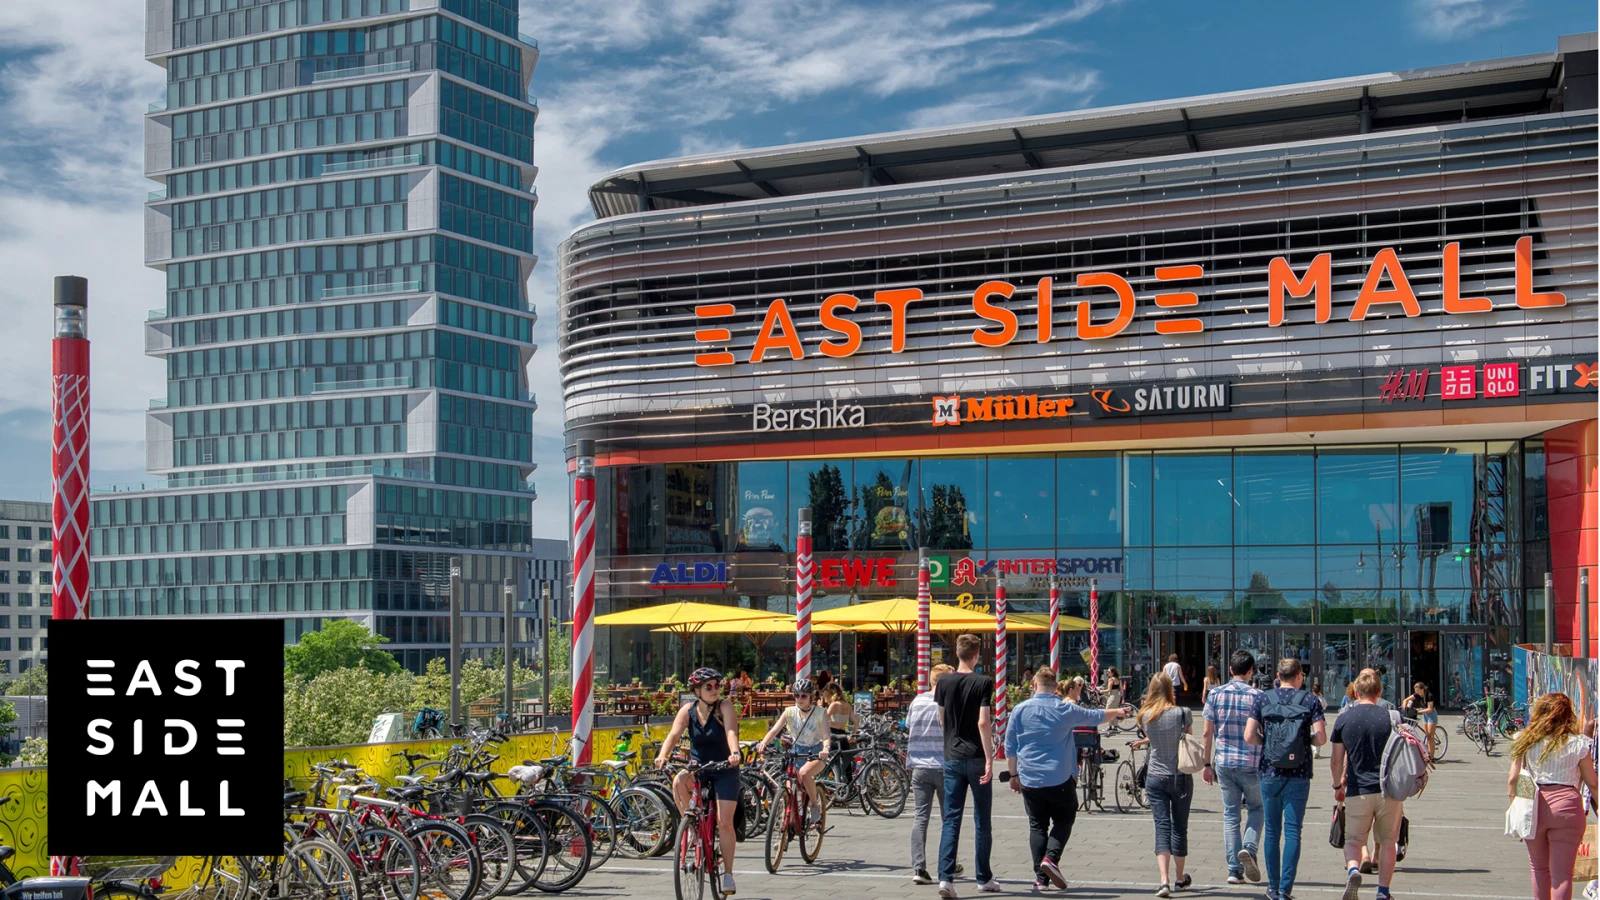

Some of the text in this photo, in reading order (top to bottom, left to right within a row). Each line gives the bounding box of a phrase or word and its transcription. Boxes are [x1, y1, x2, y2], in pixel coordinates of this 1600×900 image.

[695, 236, 1566, 366] EAST SIDE MALL
[1379, 368, 1430, 403] H&M
[1487, 366, 1512, 380] UNI
[1134, 384, 1225, 411] SATURN
[1487, 380, 1515, 394] QLO
[753, 400, 865, 432] Bershka
[966, 394, 1074, 422] Müller
[650, 562, 727, 583] ALDI
[997, 557, 1124, 575] INTERSPORT
